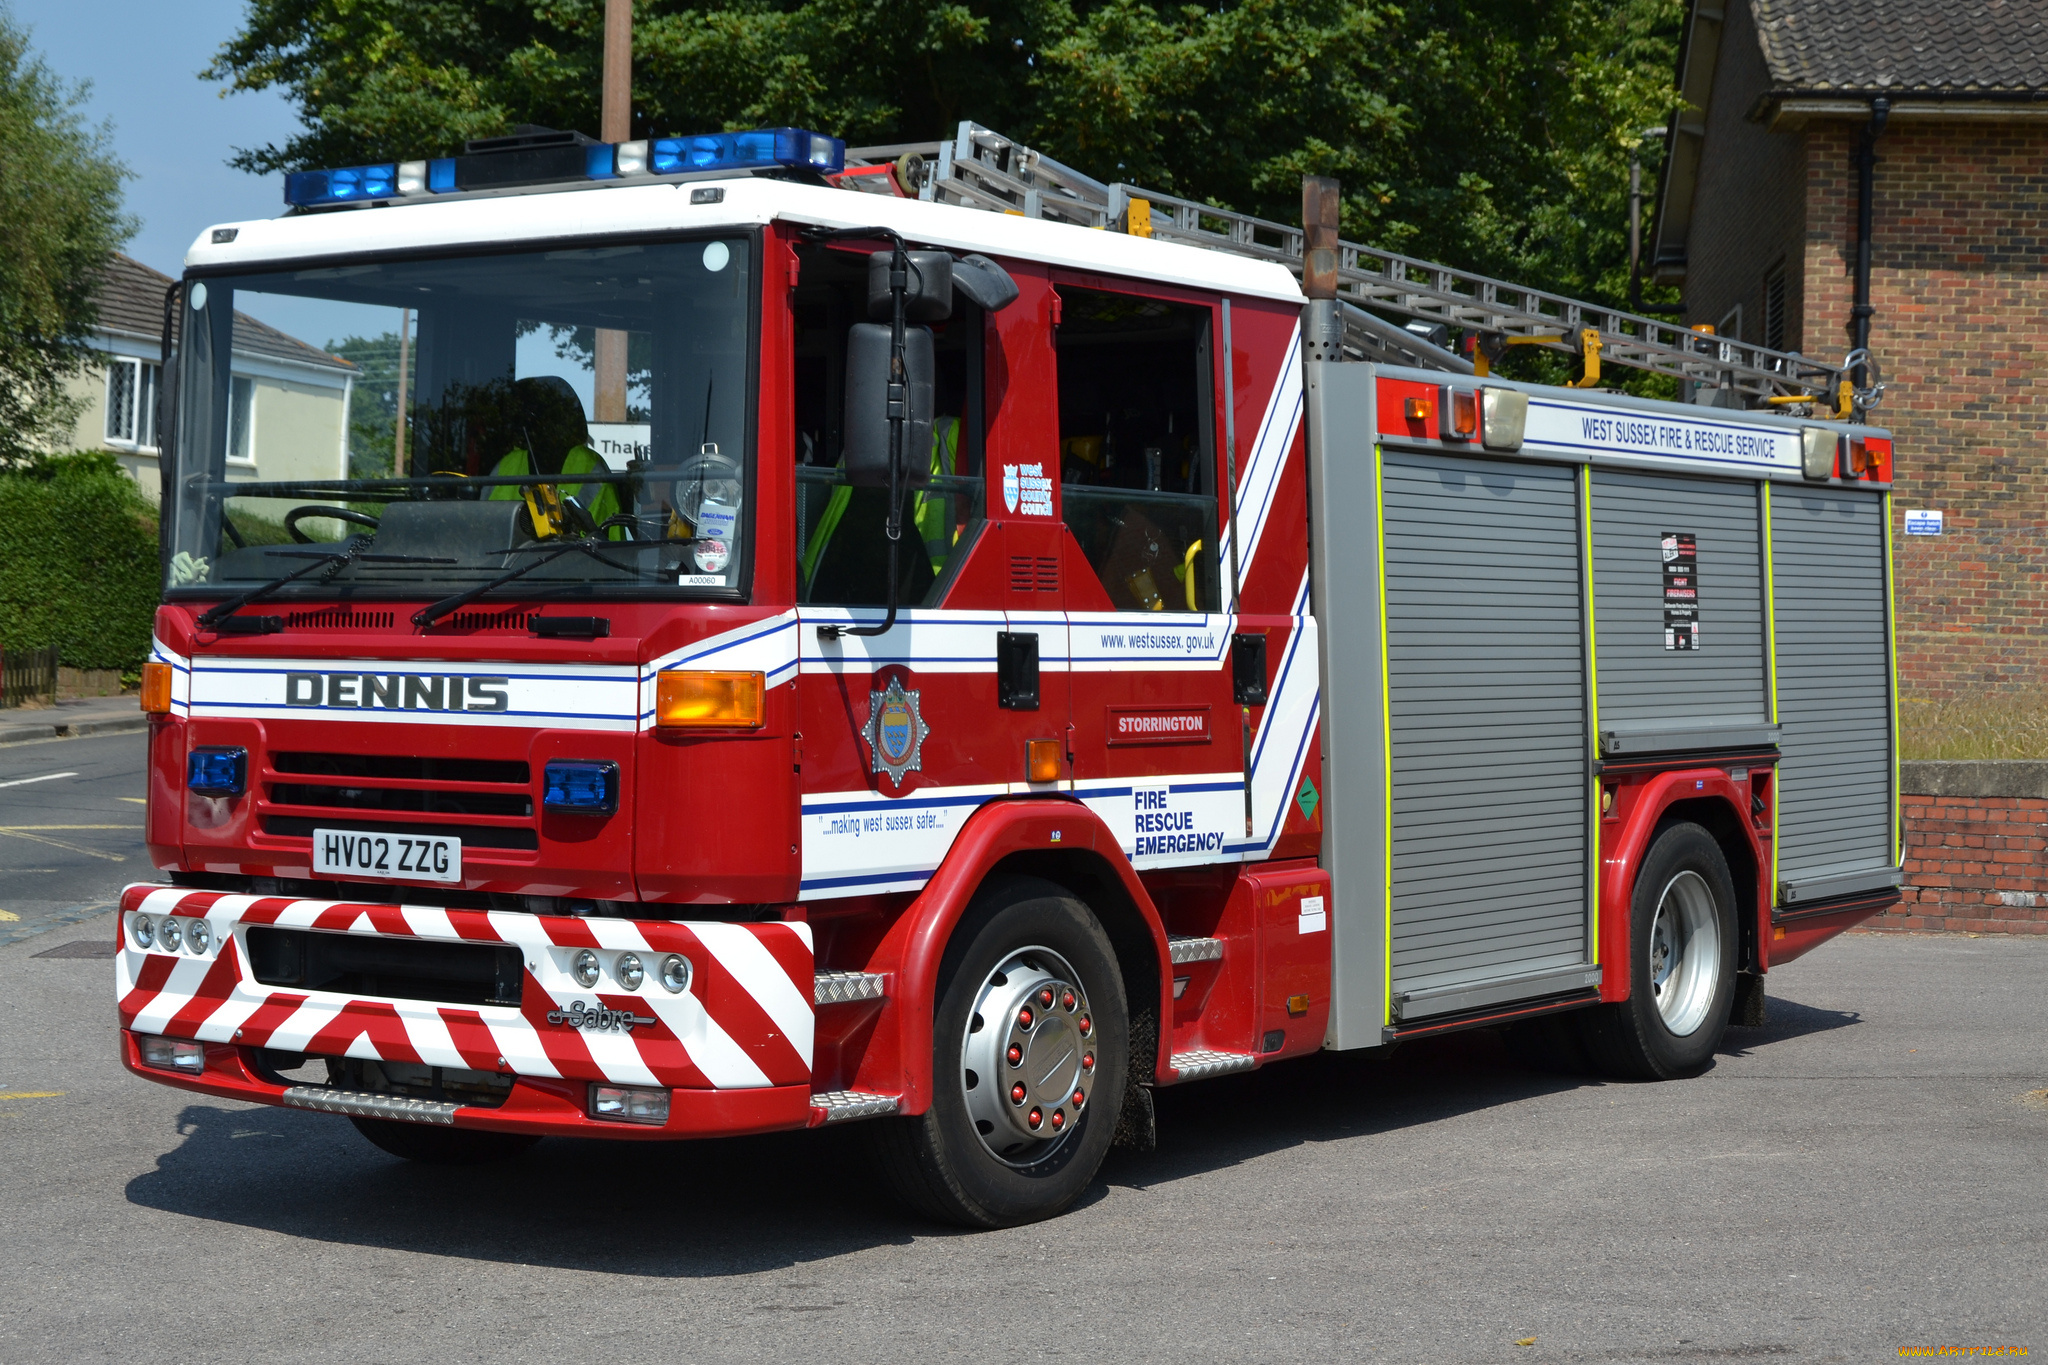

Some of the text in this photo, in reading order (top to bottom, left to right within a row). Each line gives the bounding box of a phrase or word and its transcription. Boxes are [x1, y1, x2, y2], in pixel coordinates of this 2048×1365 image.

[1582, 417, 1775, 458] WEST SUSSEX FIRE & RESCUE SERVICE
[1019, 462, 1043, 477] west
[1020, 477, 1053, 490] sussex
[1020, 490, 1051, 504] county
[1020, 502, 1053, 516] council
[1101, 632, 1215, 653] www. westsussex. gov.uk
[286, 672, 509, 713] DENNIS
[1118, 716, 1203, 732] STORRINGTON
[1135, 790, 1167, 810] FIRE
[863, 813, 883, 832] west
[885, 815, 914, 832] sussex
[1135, 811, 1193, 833] RESCUE
[325, 834, 449, 874] HV02 ZZG
[1135, 832, 1224, 856] EMERGENCY
[568, 1000, 635, 1031] Sabre
